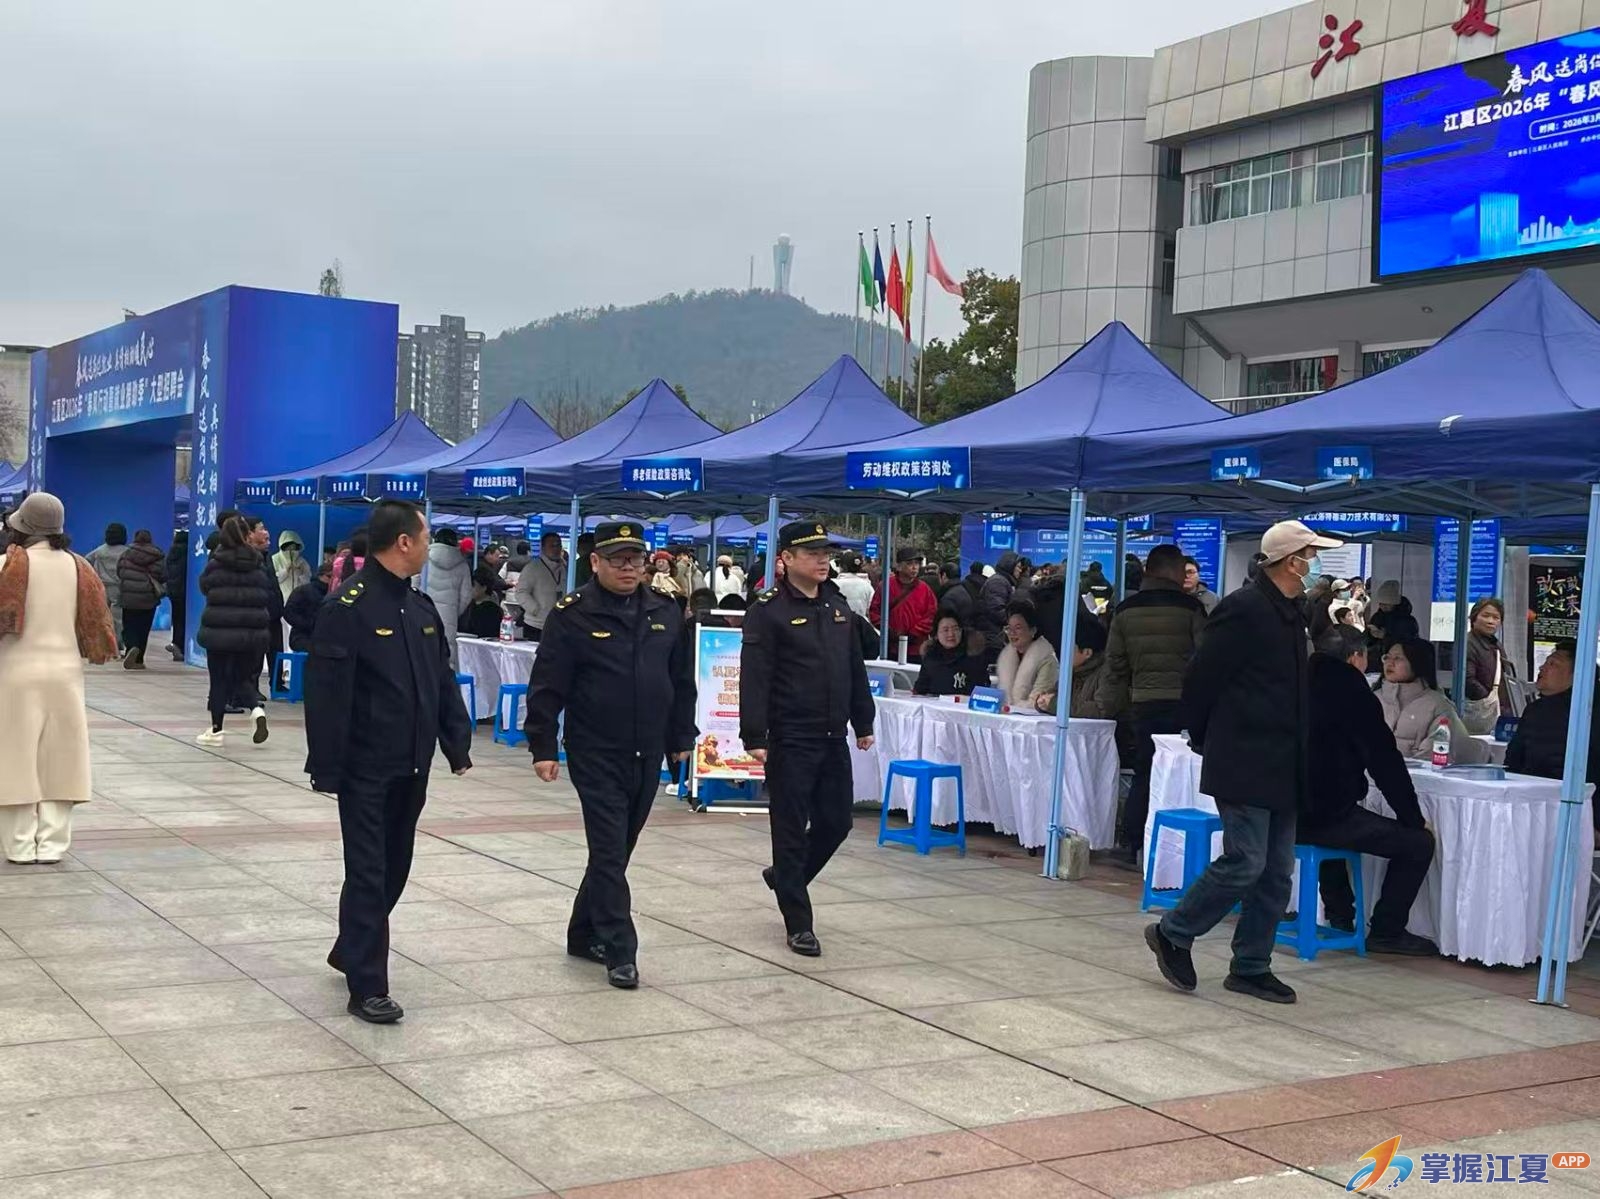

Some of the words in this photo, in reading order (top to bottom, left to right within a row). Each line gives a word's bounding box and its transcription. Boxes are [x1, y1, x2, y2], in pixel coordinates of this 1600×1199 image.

[1224, 457, 1247, 467] 医保局
[1333, 456, 1358, 467] 医保局
[632, 468, 692, 482] 养老保险政策咨询处
[862, 460, 952, 478] 劳动维权政策咨询处
